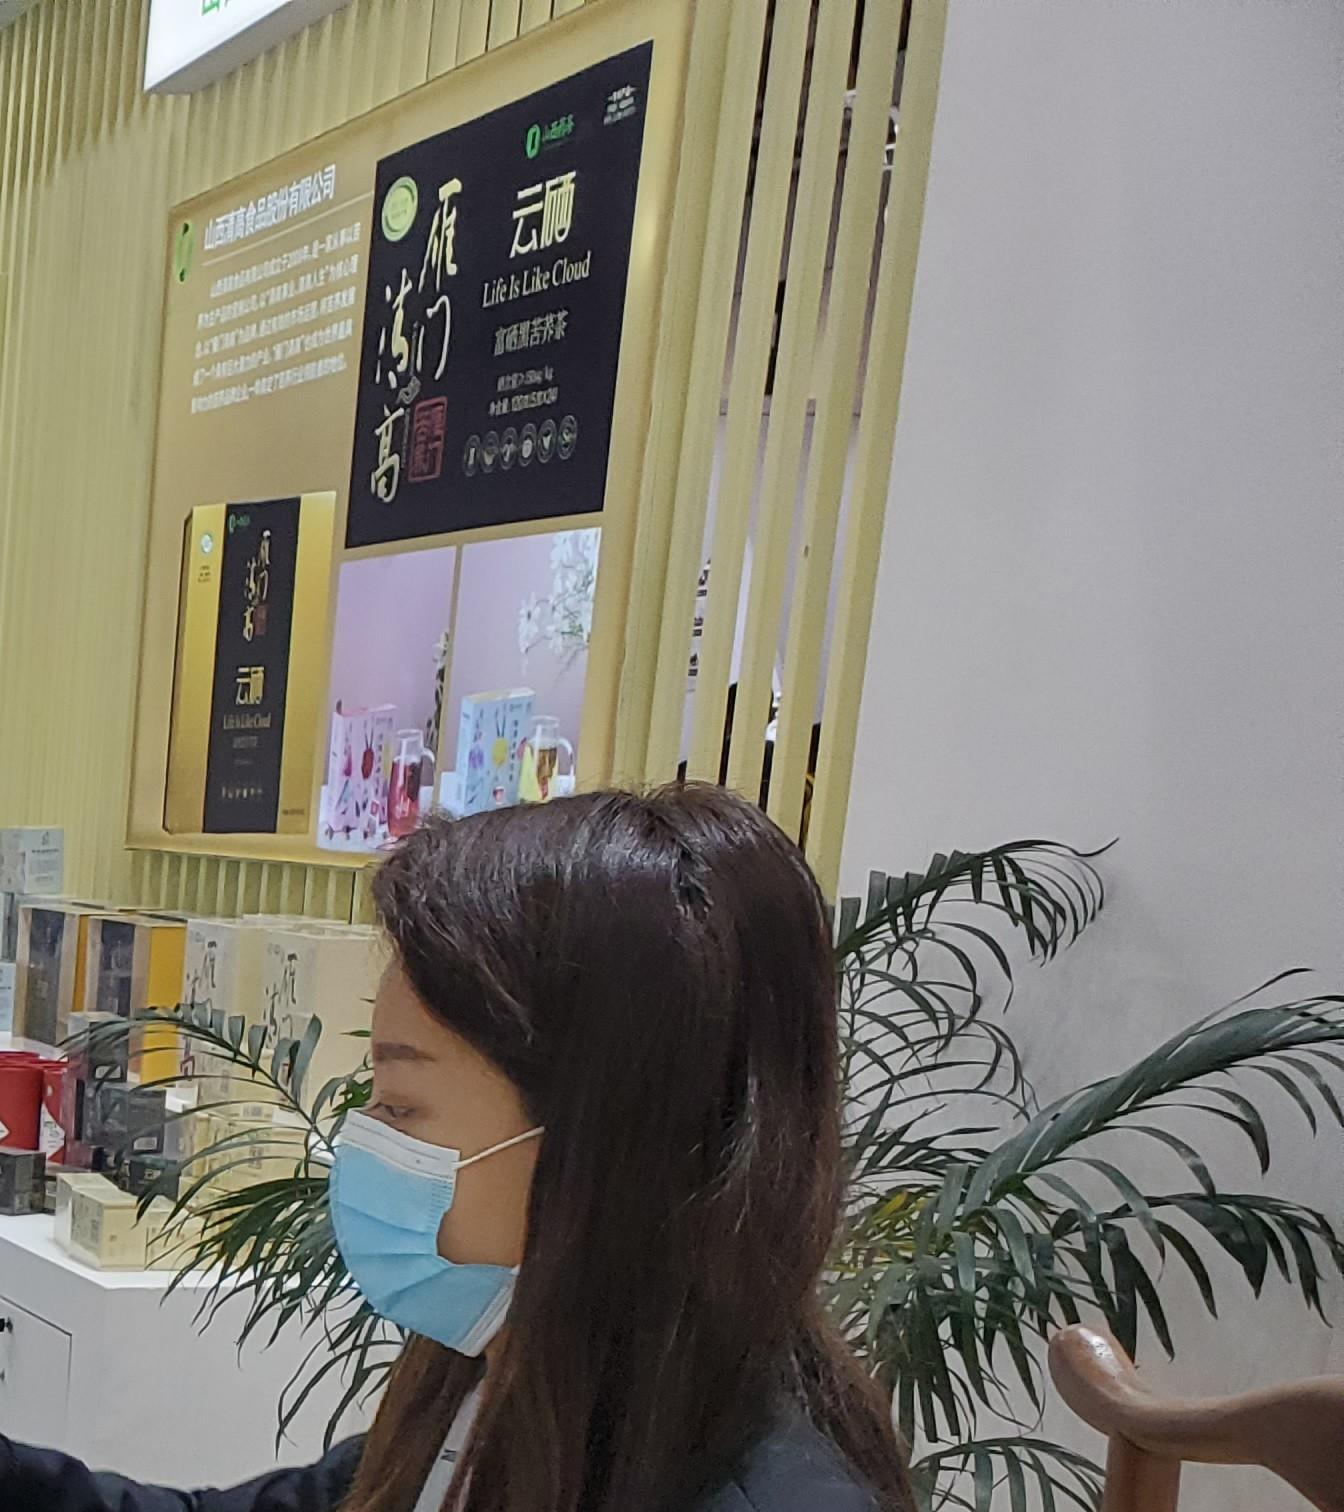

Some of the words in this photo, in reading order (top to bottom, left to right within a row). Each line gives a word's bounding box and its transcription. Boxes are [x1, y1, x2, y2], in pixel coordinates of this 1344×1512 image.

[482, 277, 507, 308] Life
[508, 274, 521, 300] Is
[522, 266, 551, 296] Like
[552, 250, 592, 286] Cloud
